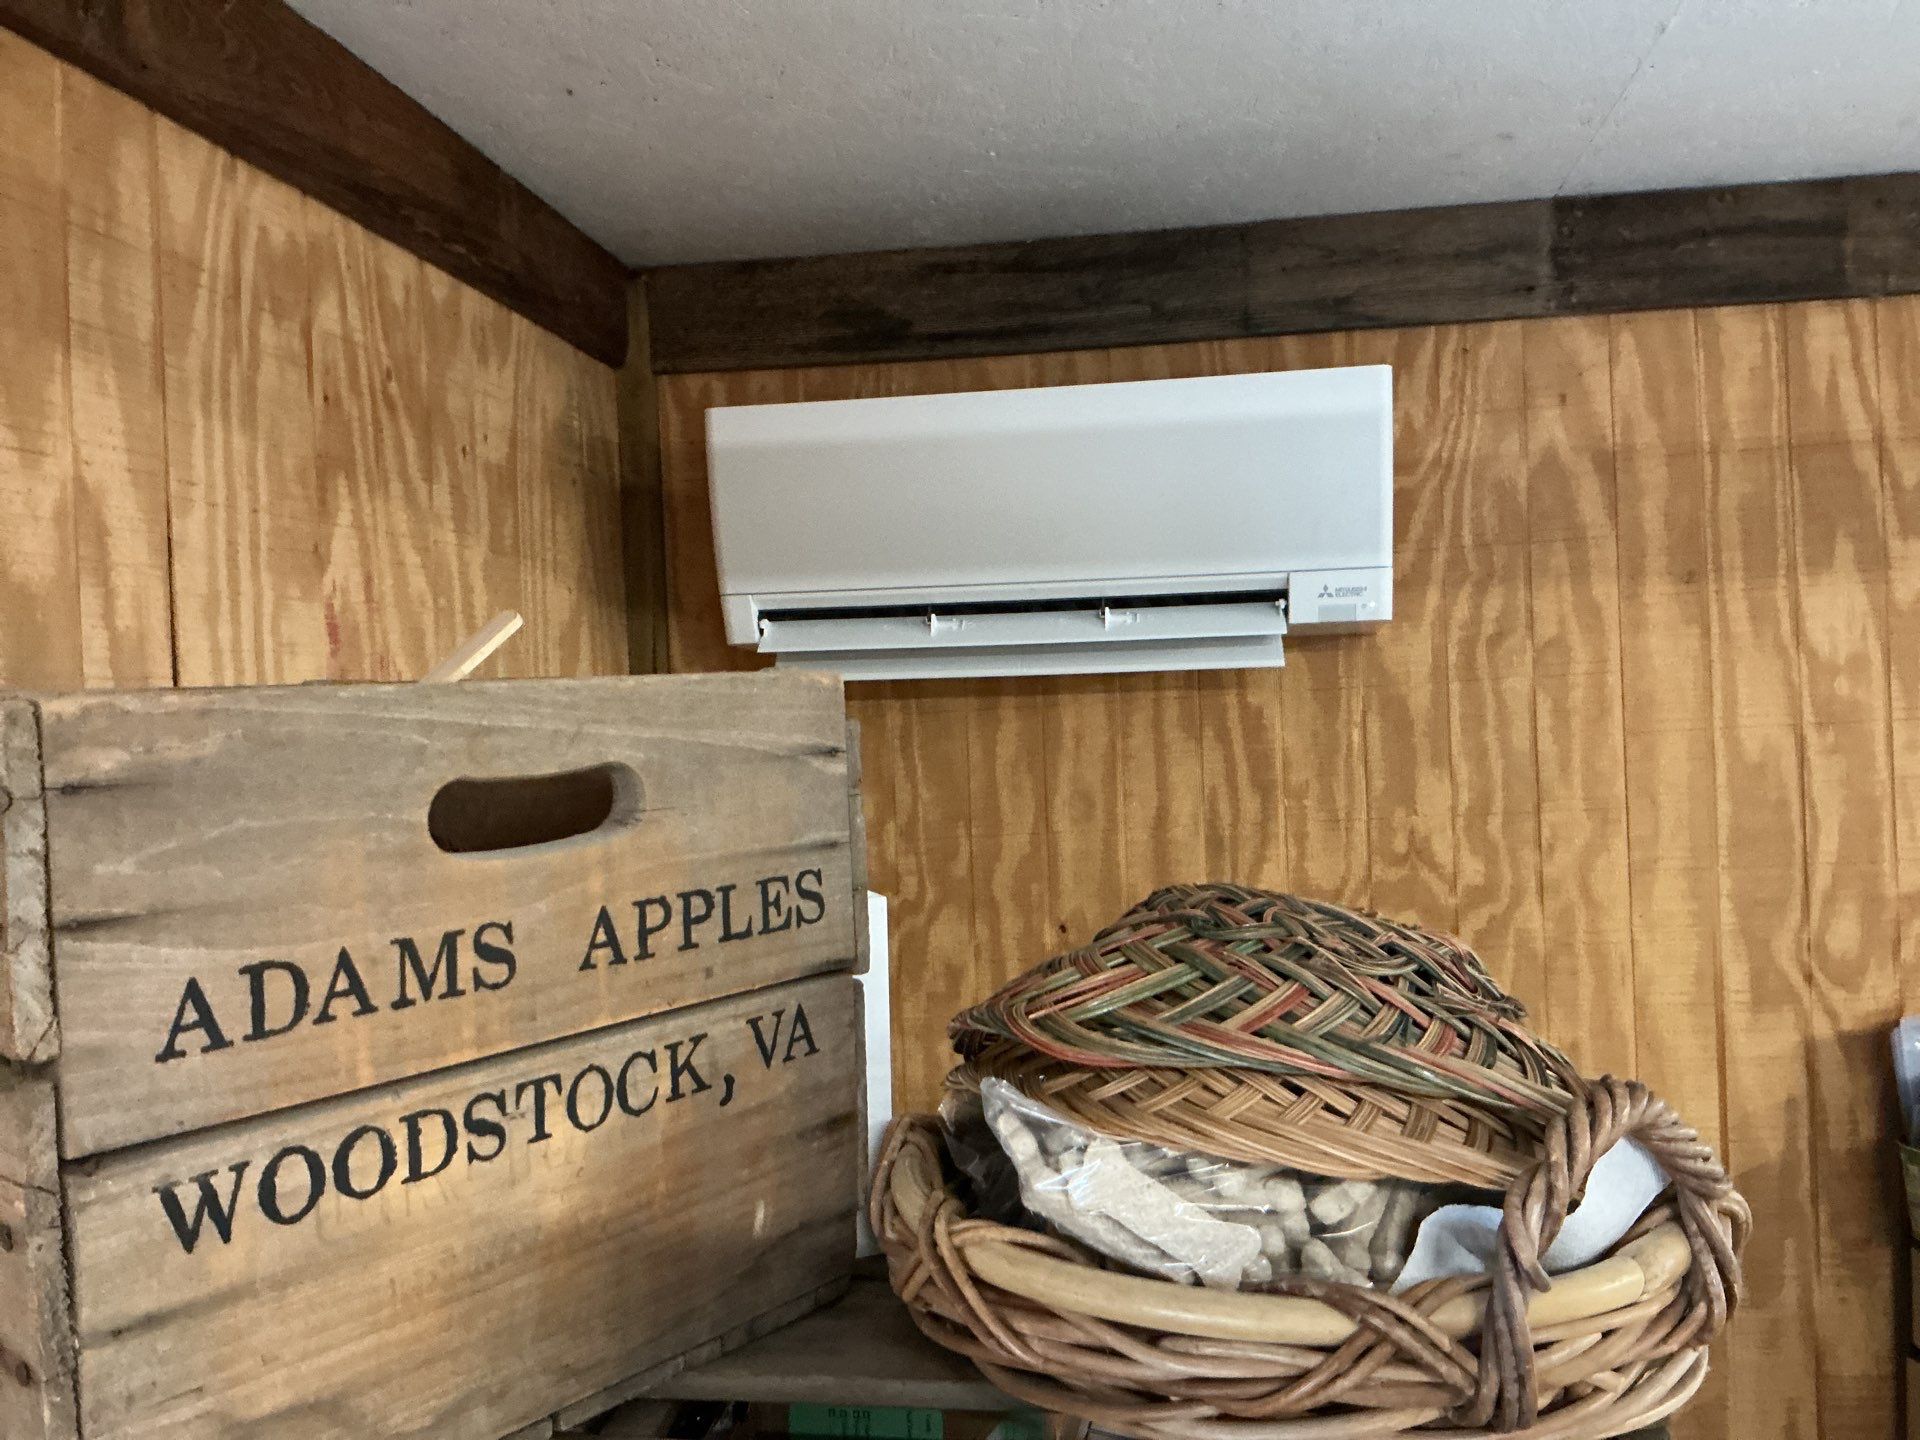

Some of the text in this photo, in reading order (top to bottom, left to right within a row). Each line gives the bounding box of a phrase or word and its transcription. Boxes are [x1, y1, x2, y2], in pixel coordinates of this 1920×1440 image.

[154, 867, 826, 1063] ADAMS APPLES
[152, 1032, 736, 1255] WOODSTOCK,
[746, 1003, 820, 1070] VA
